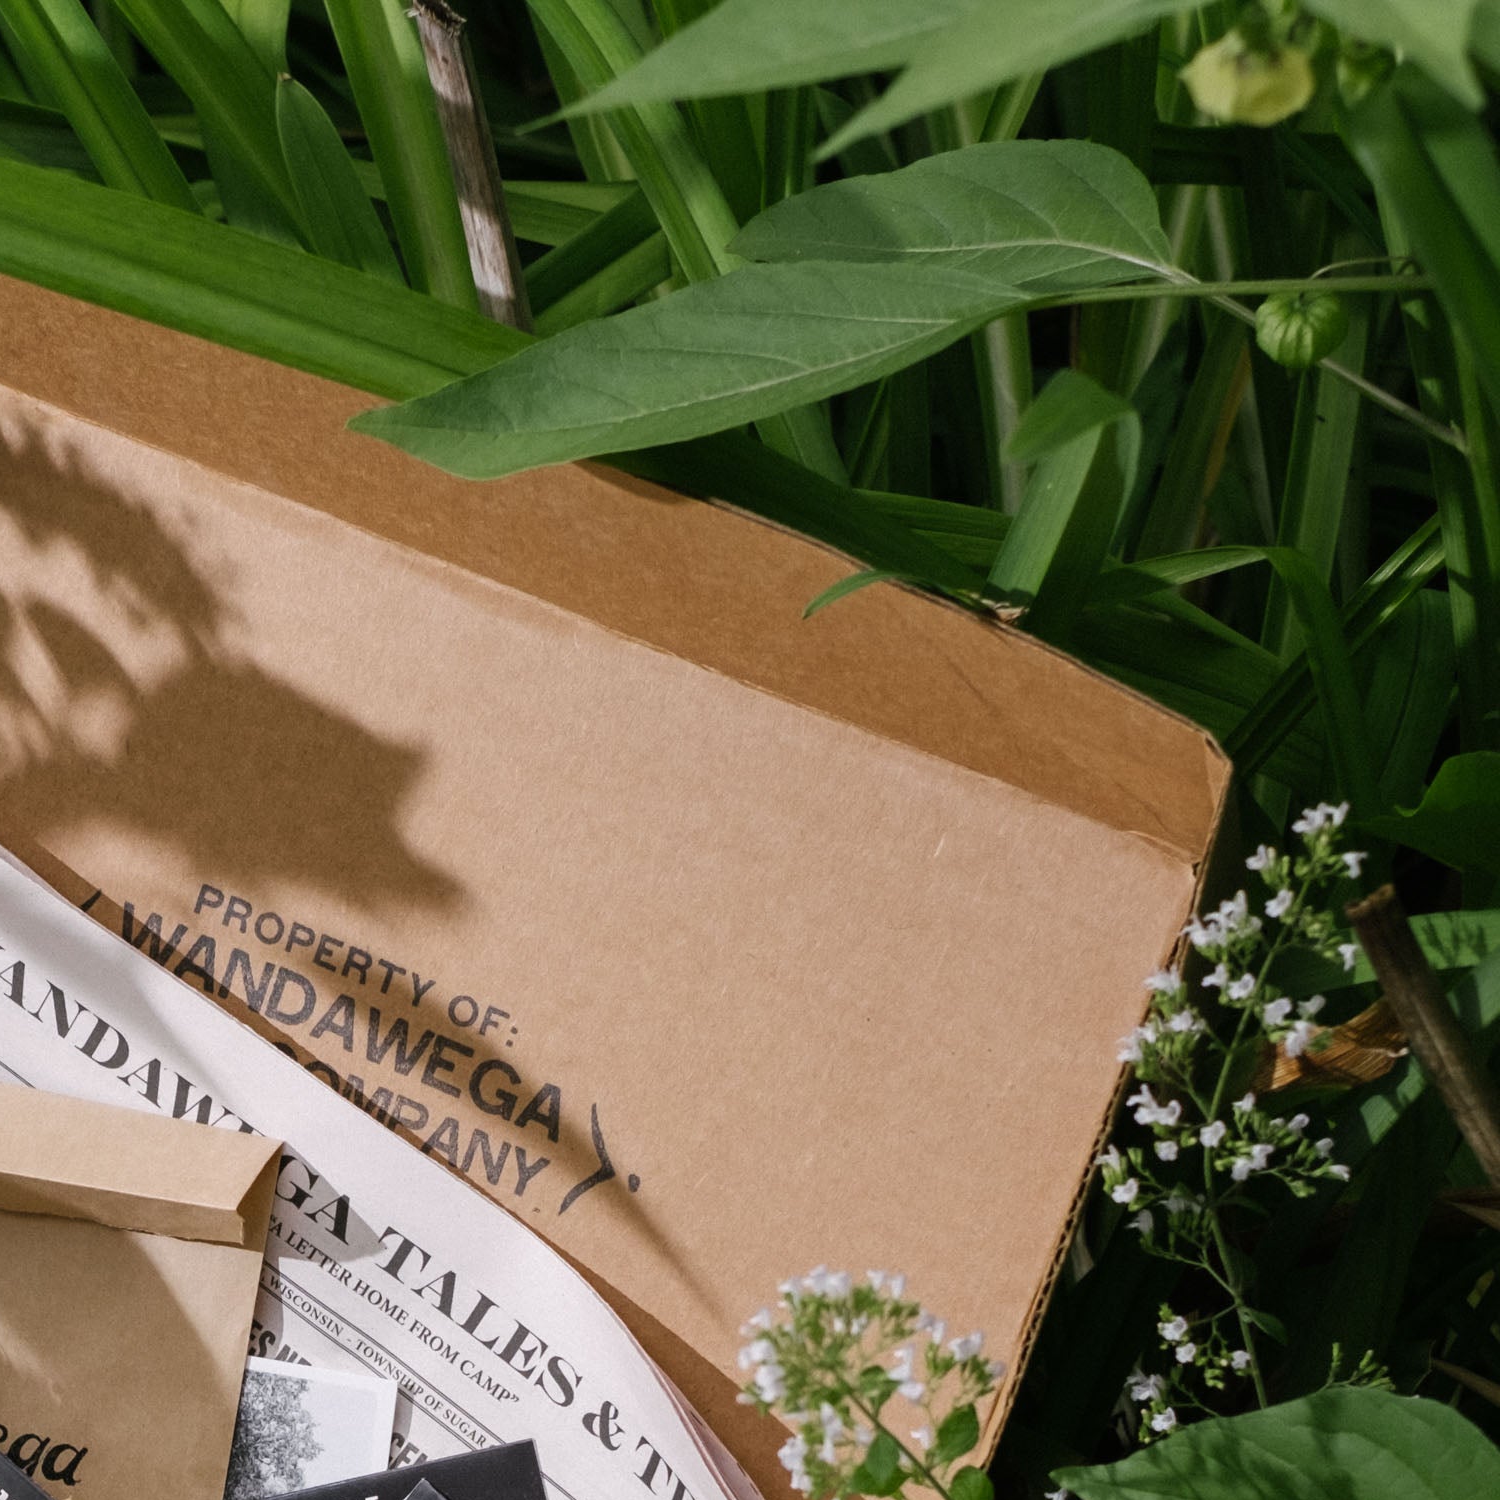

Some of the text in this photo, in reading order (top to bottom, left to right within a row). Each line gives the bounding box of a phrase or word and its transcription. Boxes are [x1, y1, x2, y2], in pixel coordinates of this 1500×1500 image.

[122, 900, 562, 1144] WANDAWEGA
[193, 884, 519, 1048] PROPERTY OF:
[269, 1274, 345, 1338] WISCONSIN
[355, 1337, 425, 1397] TOWNSHIP
[423, 1392, 445, 1413] OF
[442, 1405, 488, 1449] SUGAR
[284, 1226, 352, 1286] LETTER
[351, 1278, 409, 1327] HOME
[408, 1318, 460, 1371] FROM
[459, 1358, 520, 1405] CAMP”
[374, 1226, 584, 1409] TALES
[582, 1400, 626, 1451] &
